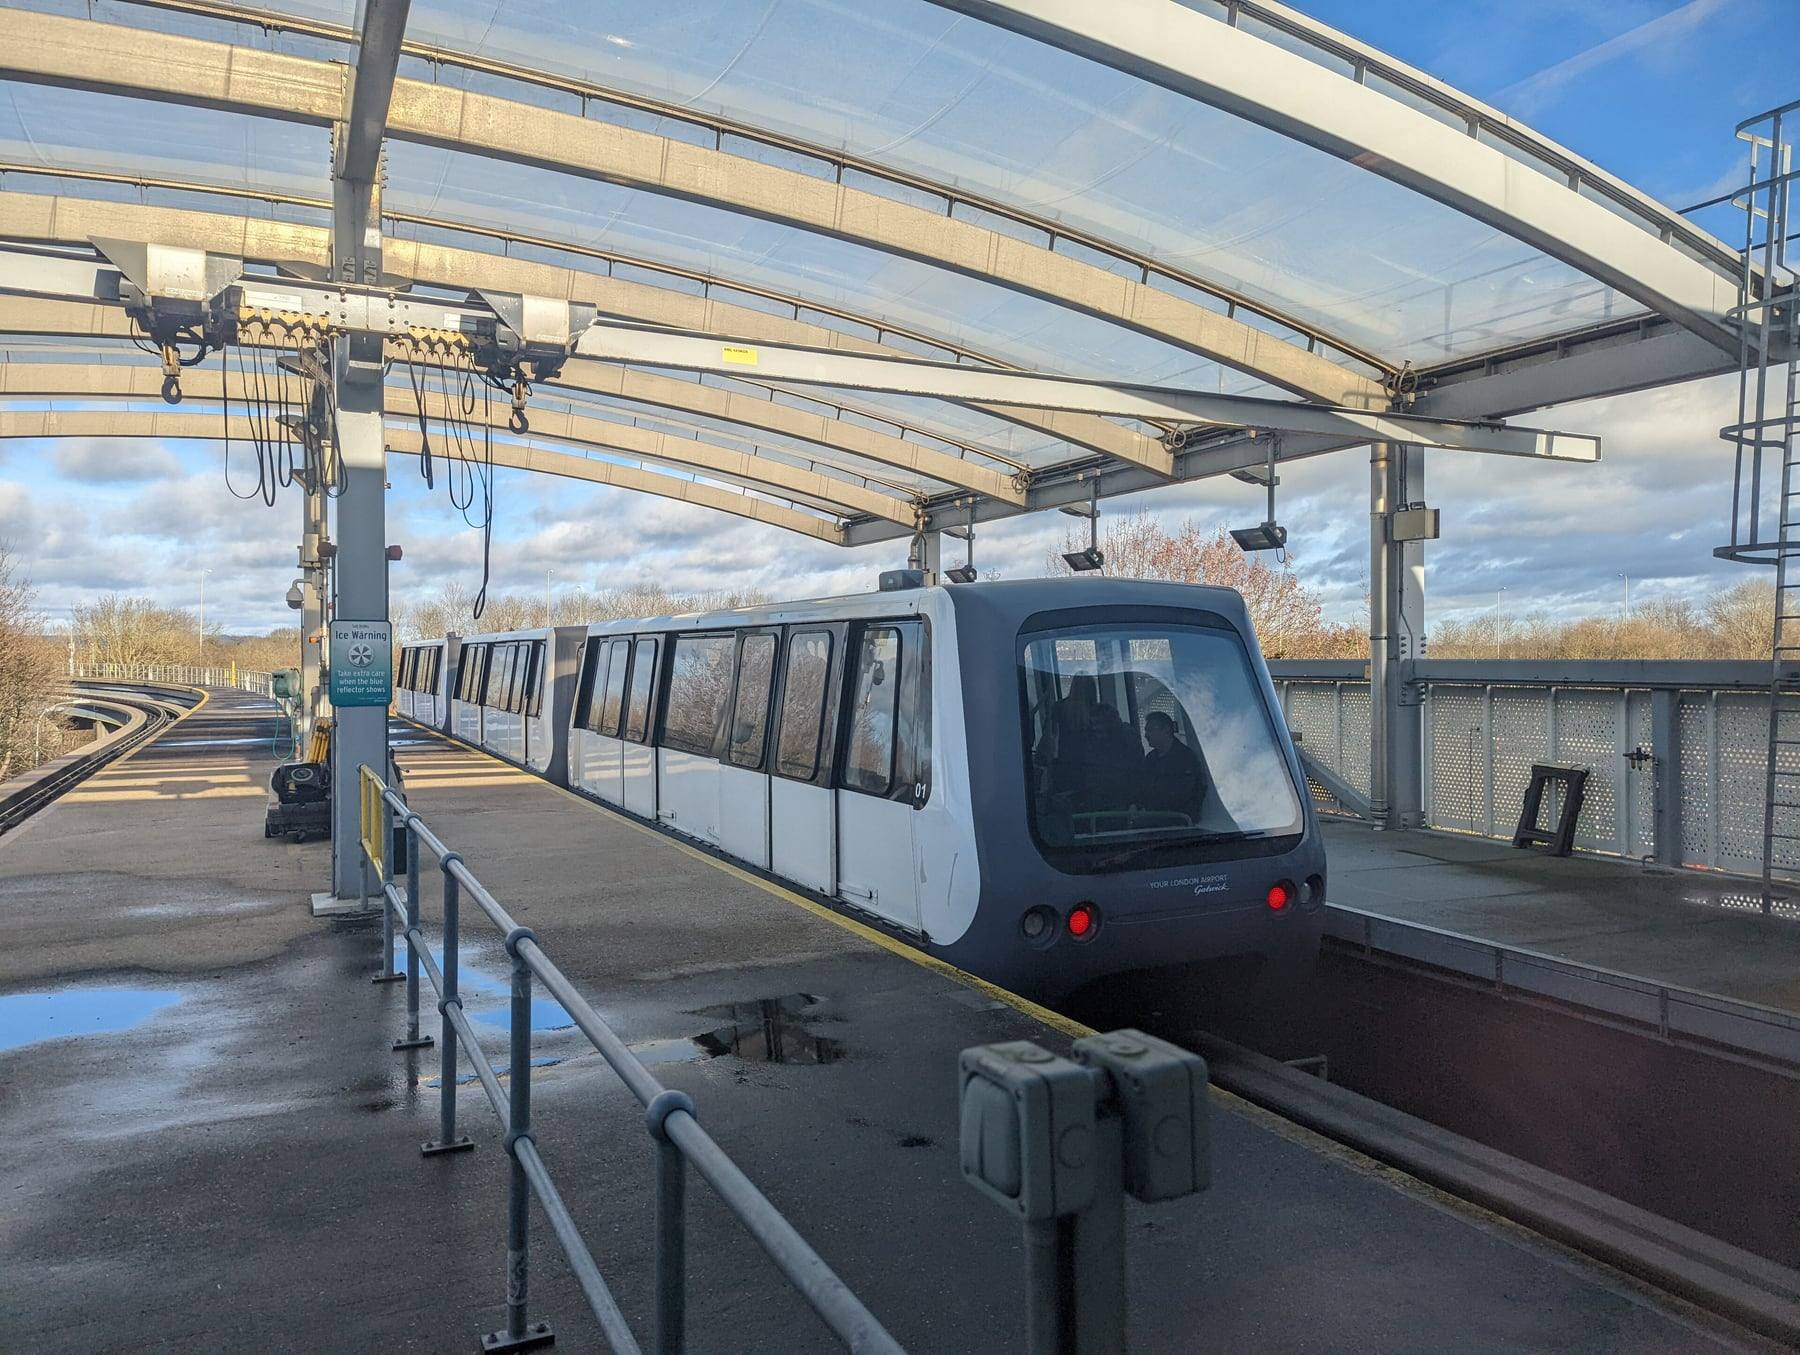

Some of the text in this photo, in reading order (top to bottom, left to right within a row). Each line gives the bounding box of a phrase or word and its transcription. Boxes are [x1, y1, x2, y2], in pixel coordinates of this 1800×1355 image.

[335, 630, 387, 642] Ice Warning
[915, 782, 927, 799] 01
[1150, 874, 1228, 889] YOUR LONDON AIRPORT
[1194, 883, 1230, 896] Gatwick
